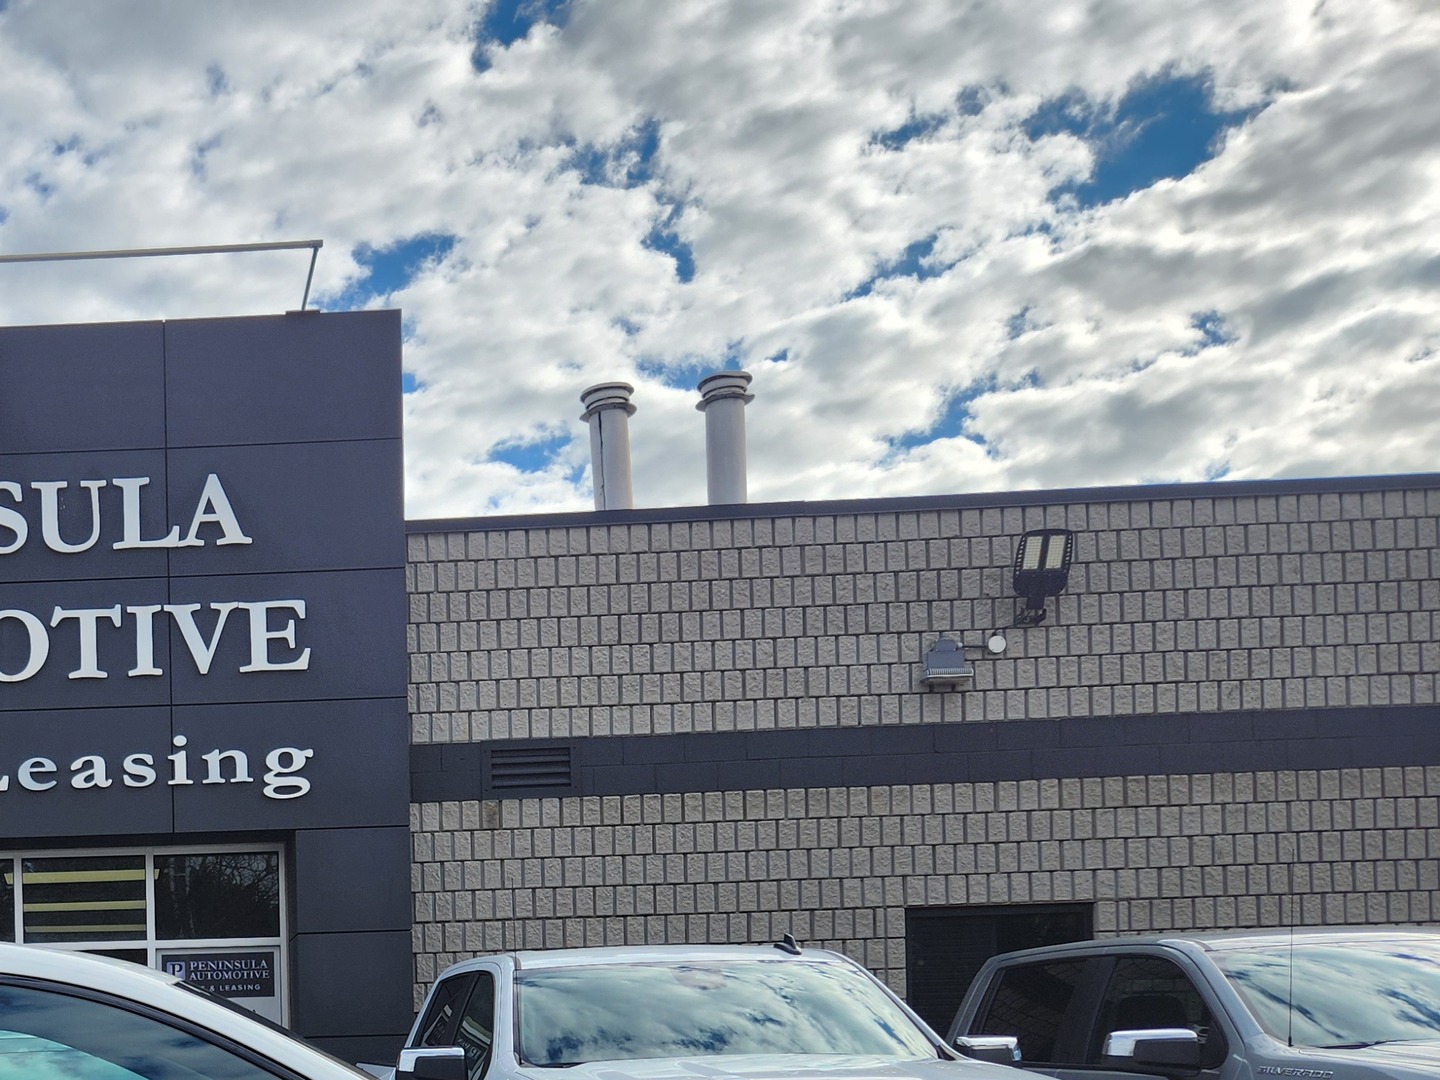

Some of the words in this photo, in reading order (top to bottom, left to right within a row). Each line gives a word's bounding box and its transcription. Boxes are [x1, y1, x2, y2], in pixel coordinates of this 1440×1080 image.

[189, 959, 268, 971] PENINSULA
[189, 970, 270, 981] AUTOMOTIVE
[219, 984, 261, 992] LEASING
[1257, 1065, 1334, 1079] SILVERADO
